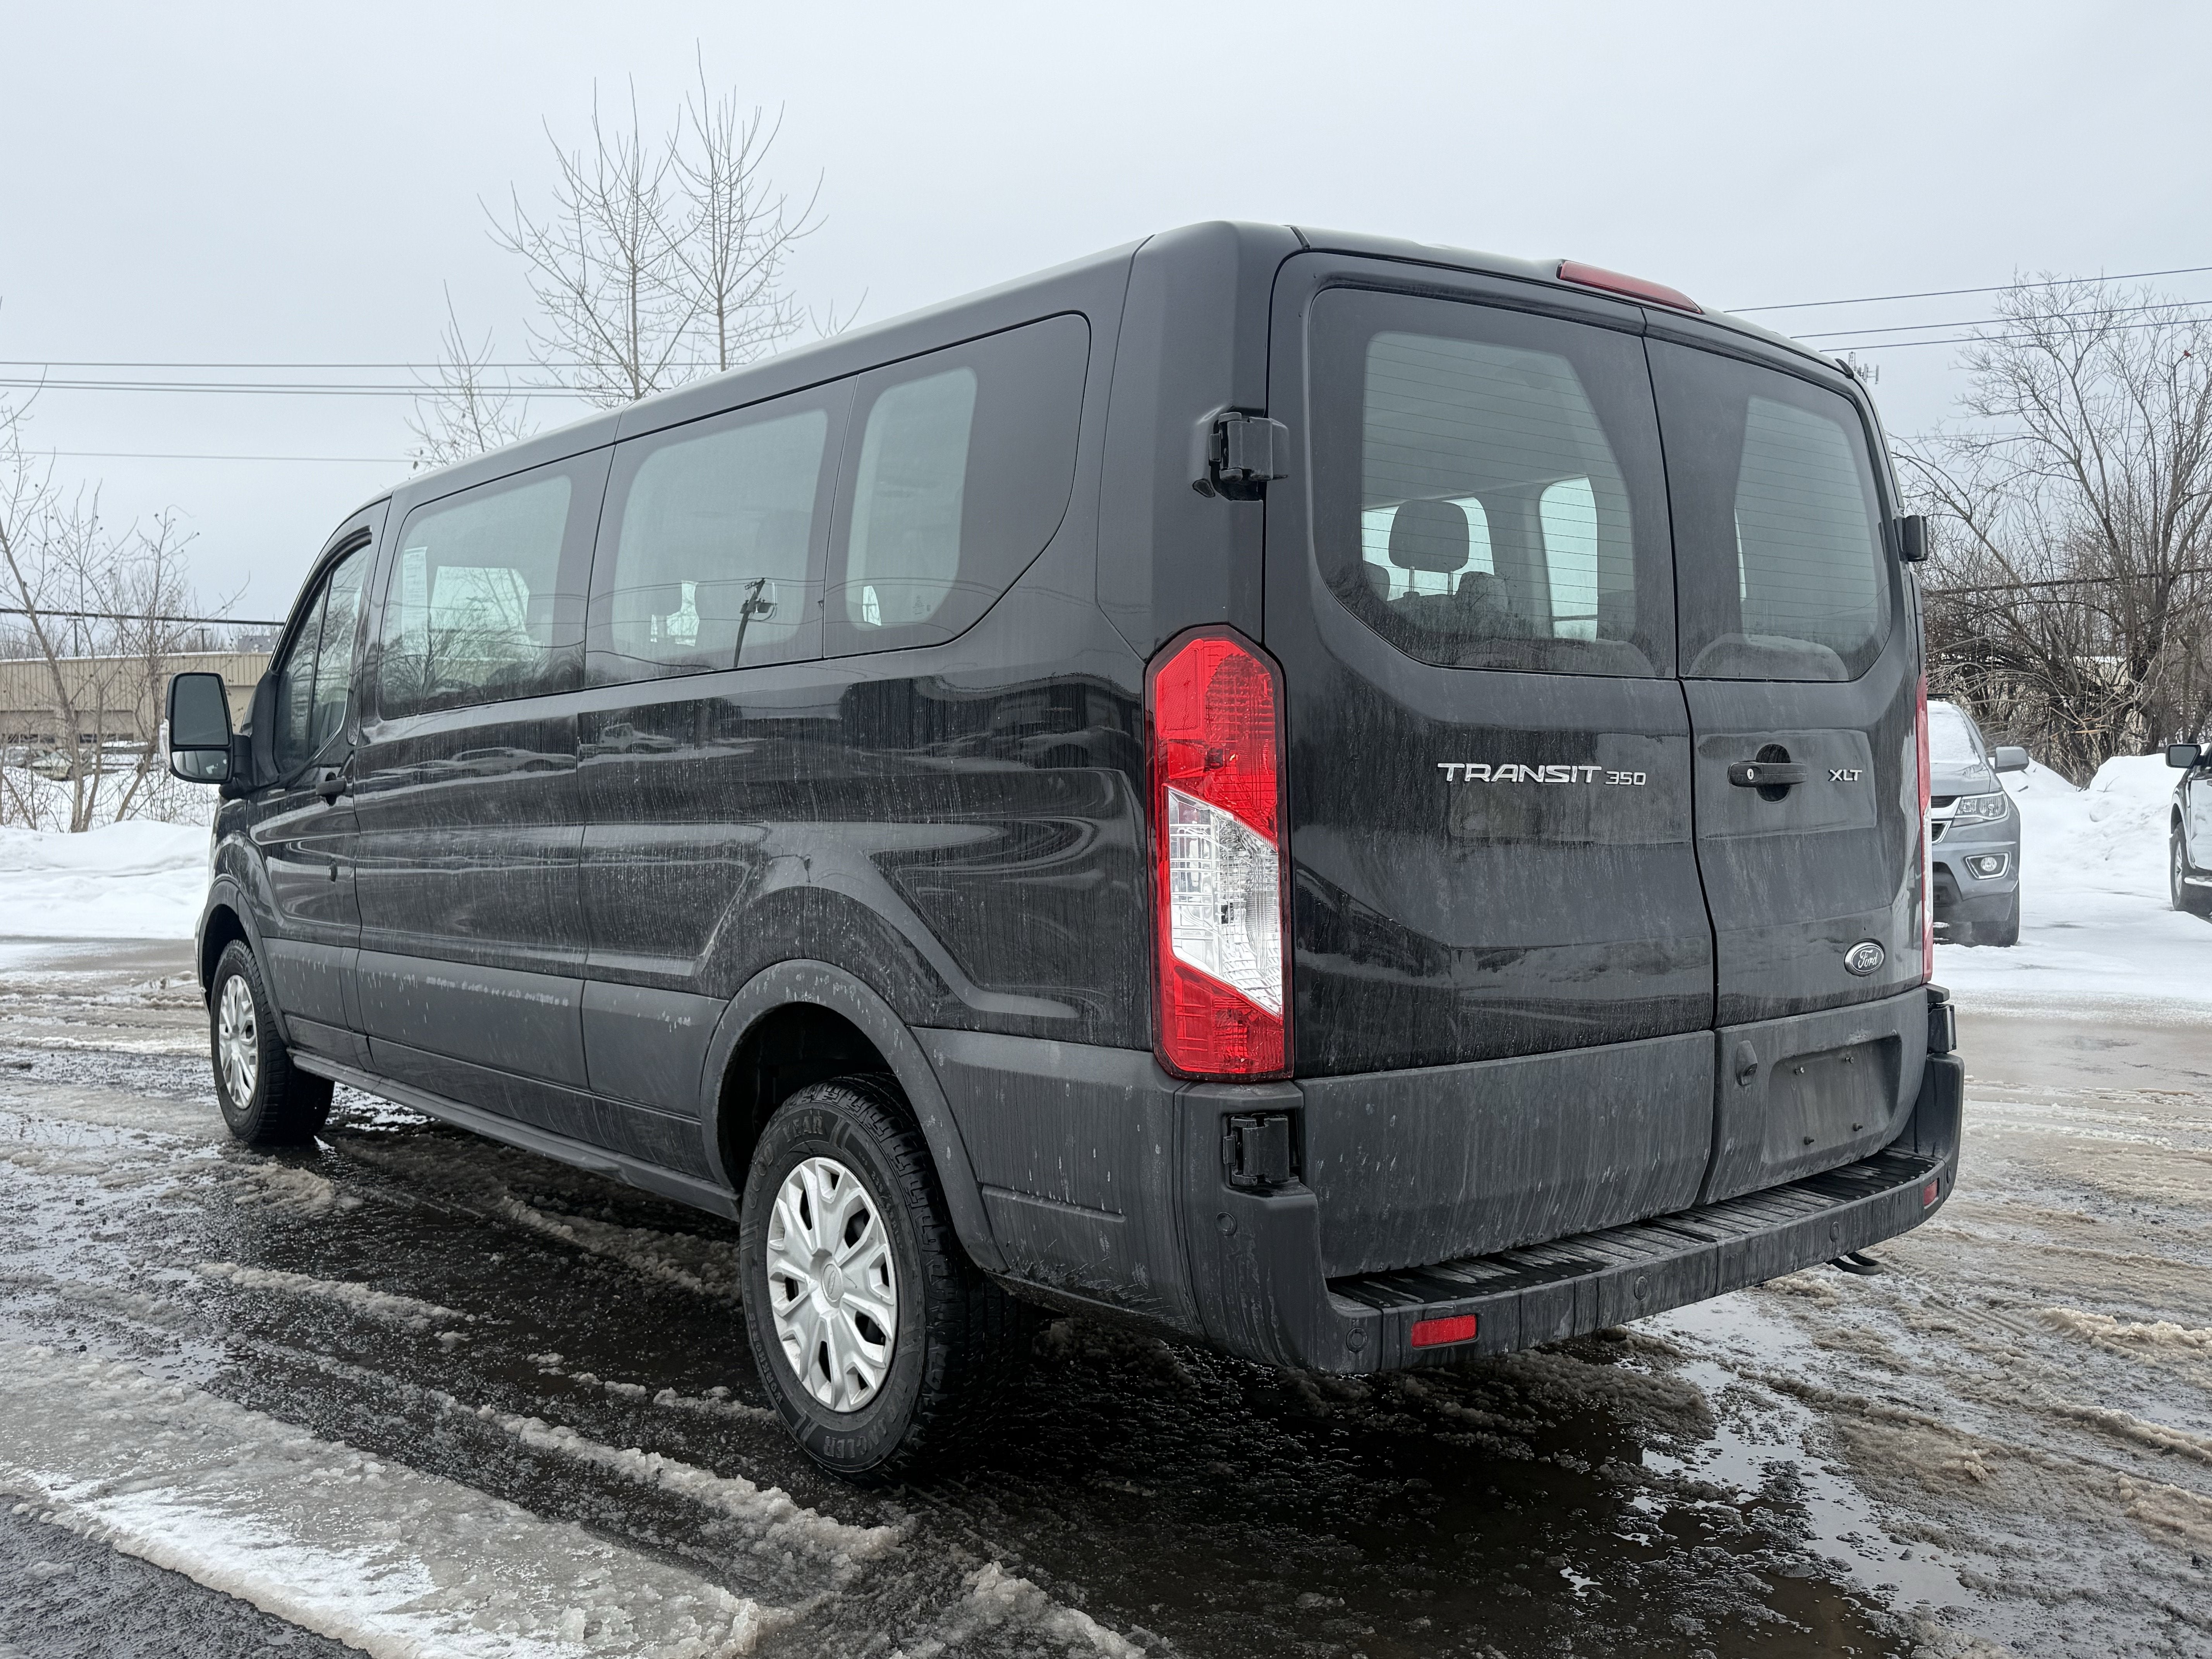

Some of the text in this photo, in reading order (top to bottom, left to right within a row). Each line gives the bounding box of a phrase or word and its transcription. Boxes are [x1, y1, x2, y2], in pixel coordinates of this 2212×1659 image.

[1437, 763, 1646, 785] TRANSIT 350
[1829, 769, 1863, 781] XLT
[1858, 950, 1878, 969] Ford
